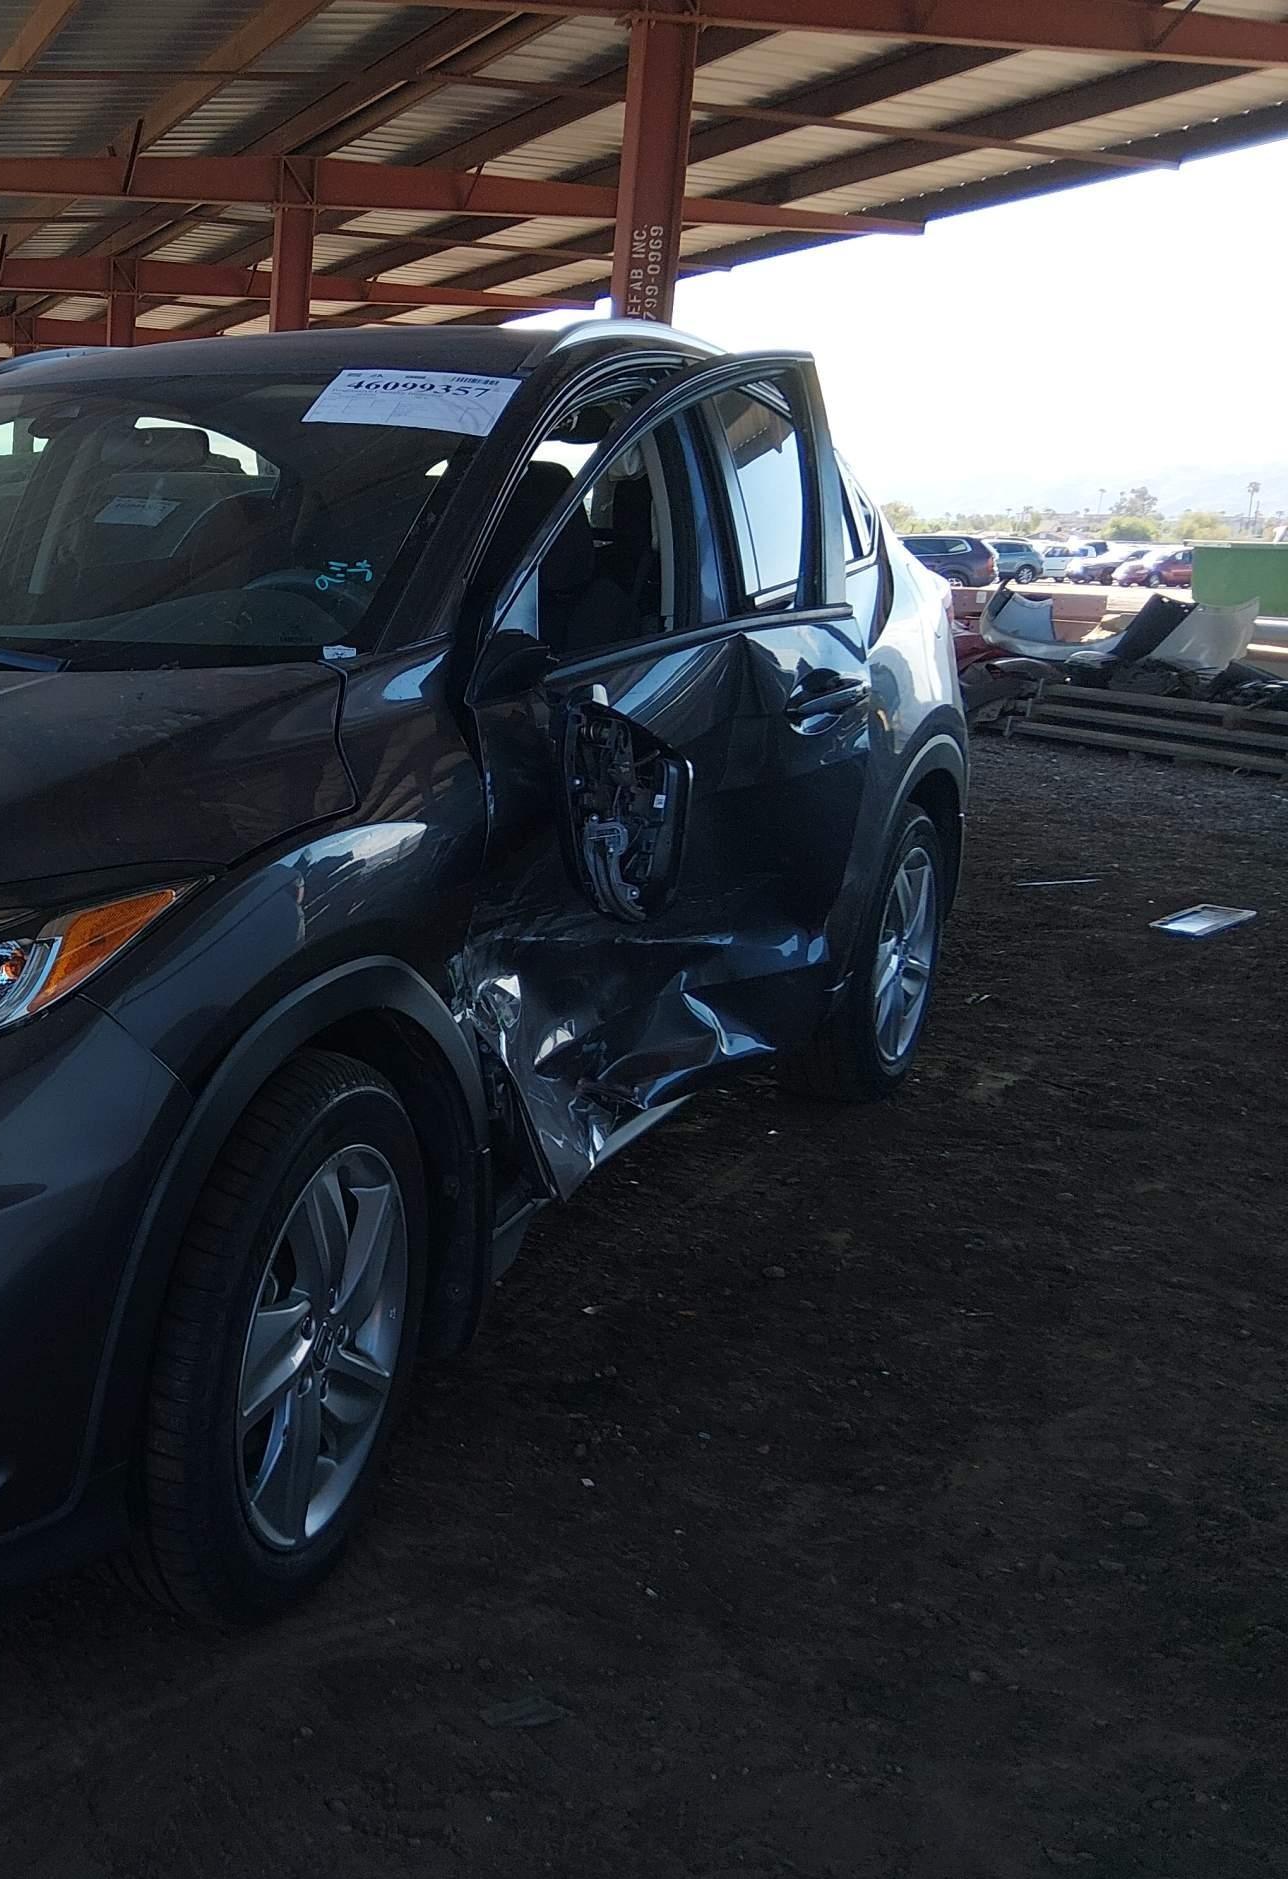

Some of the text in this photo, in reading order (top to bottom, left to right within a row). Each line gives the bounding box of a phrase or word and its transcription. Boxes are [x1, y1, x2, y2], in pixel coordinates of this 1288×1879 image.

[632, 224, 648, 259] INC.
[643, 225, 664, 321] 799-0969
[346, 380, 491, 398] 46099357
